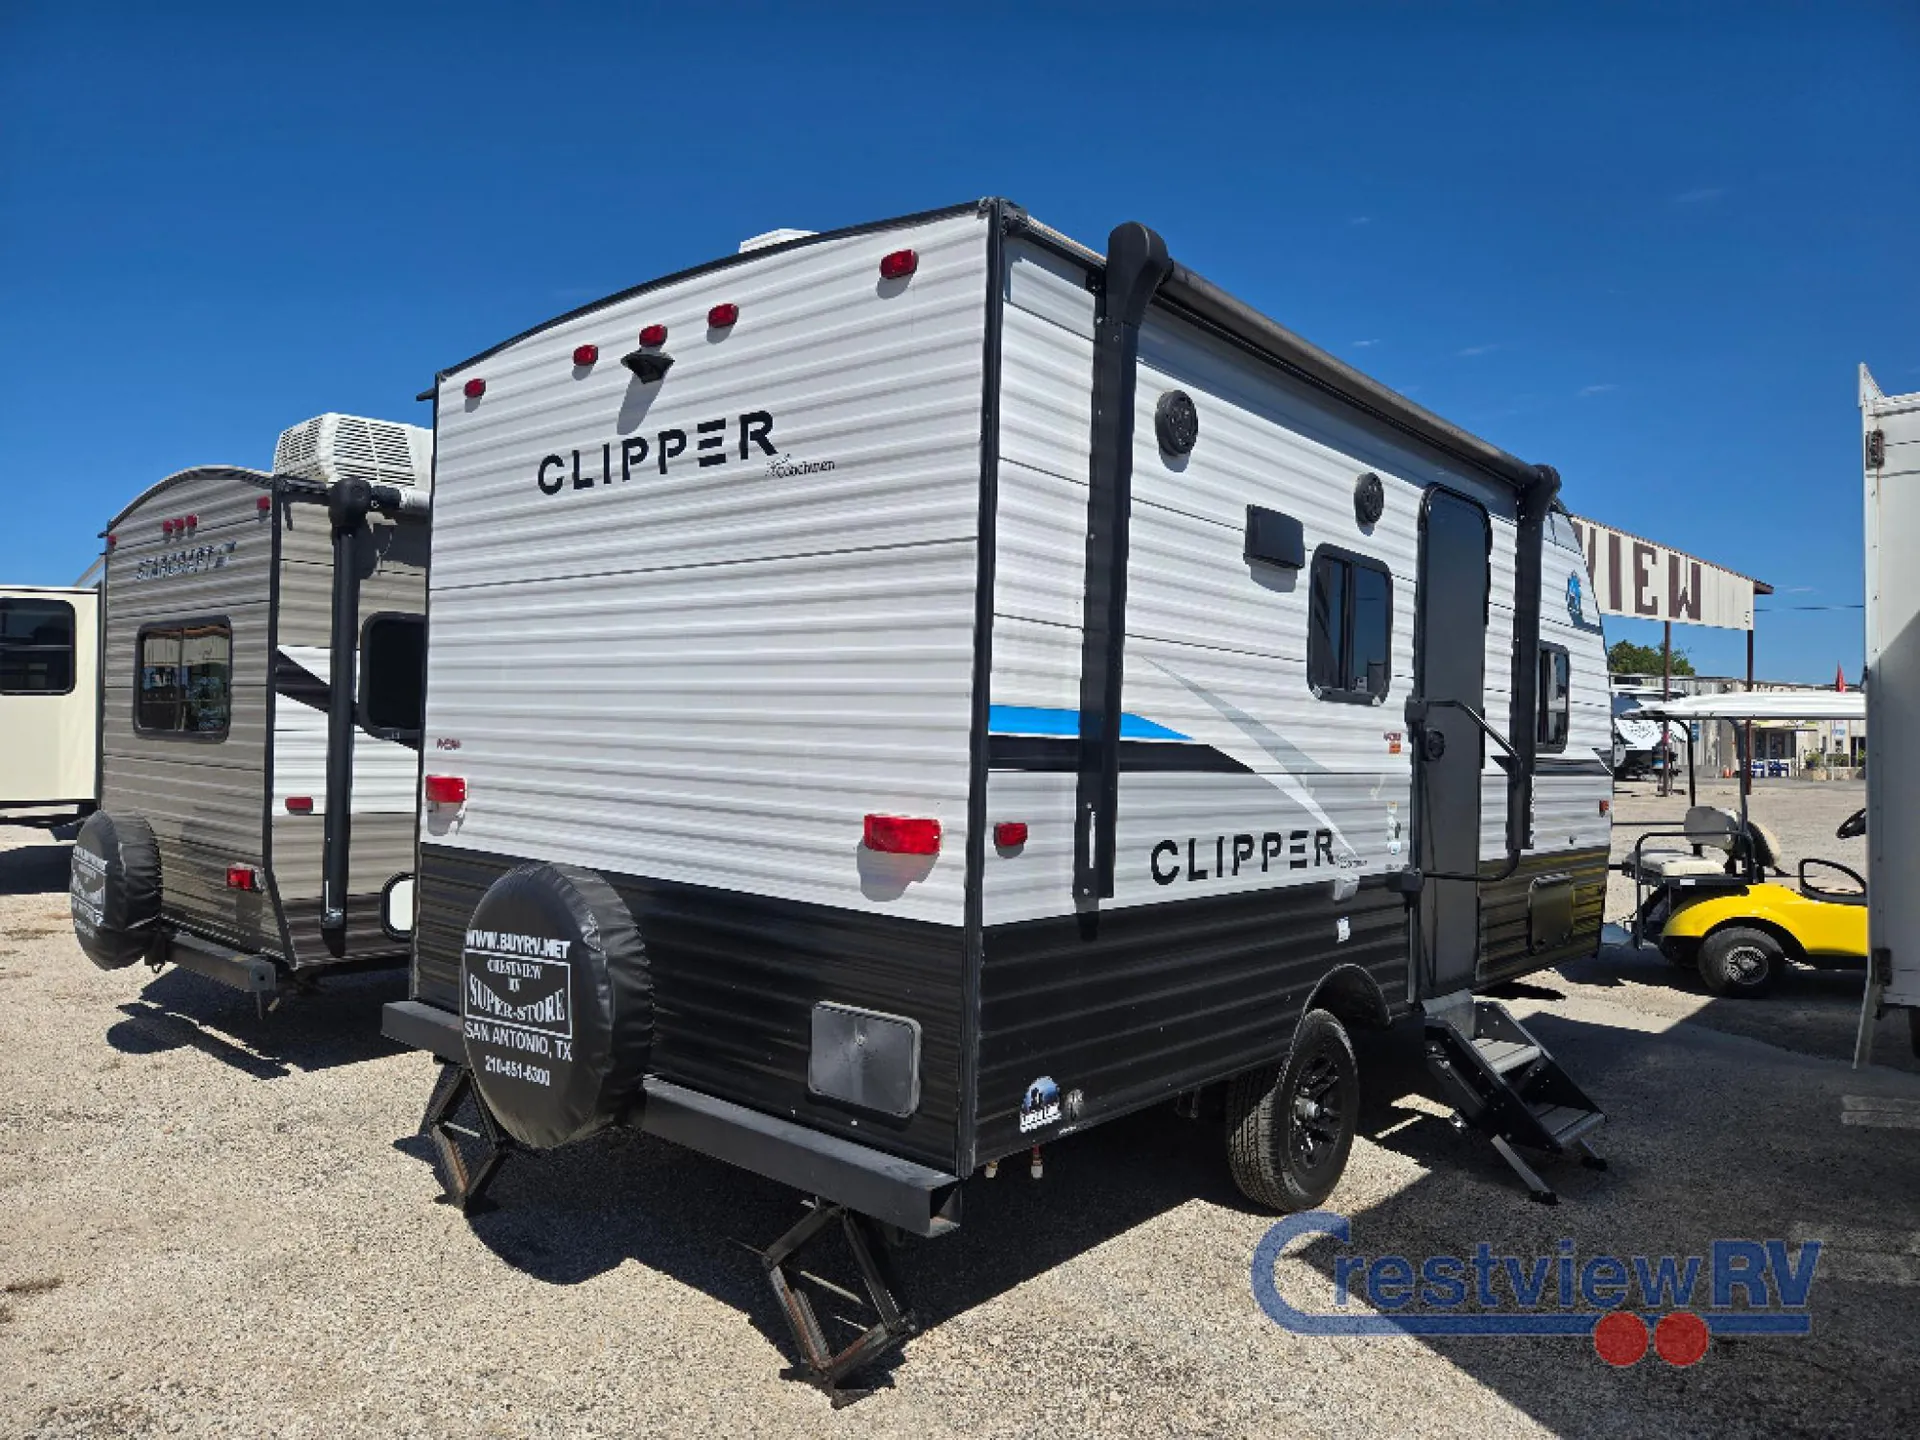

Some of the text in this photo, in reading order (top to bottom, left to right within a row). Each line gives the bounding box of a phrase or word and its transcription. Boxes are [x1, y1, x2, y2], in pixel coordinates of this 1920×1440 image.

[537, 410, 777, 494] CLIPPER
[1150, 828, 1335, 886] CLIPPER
[466, 929, 571, 959] WWW.BUYRV.NET
[469, 973, 566, 1023] SUPER-STORE
[464, 1021, 573, 1062] SAN ANTONIO, TX
